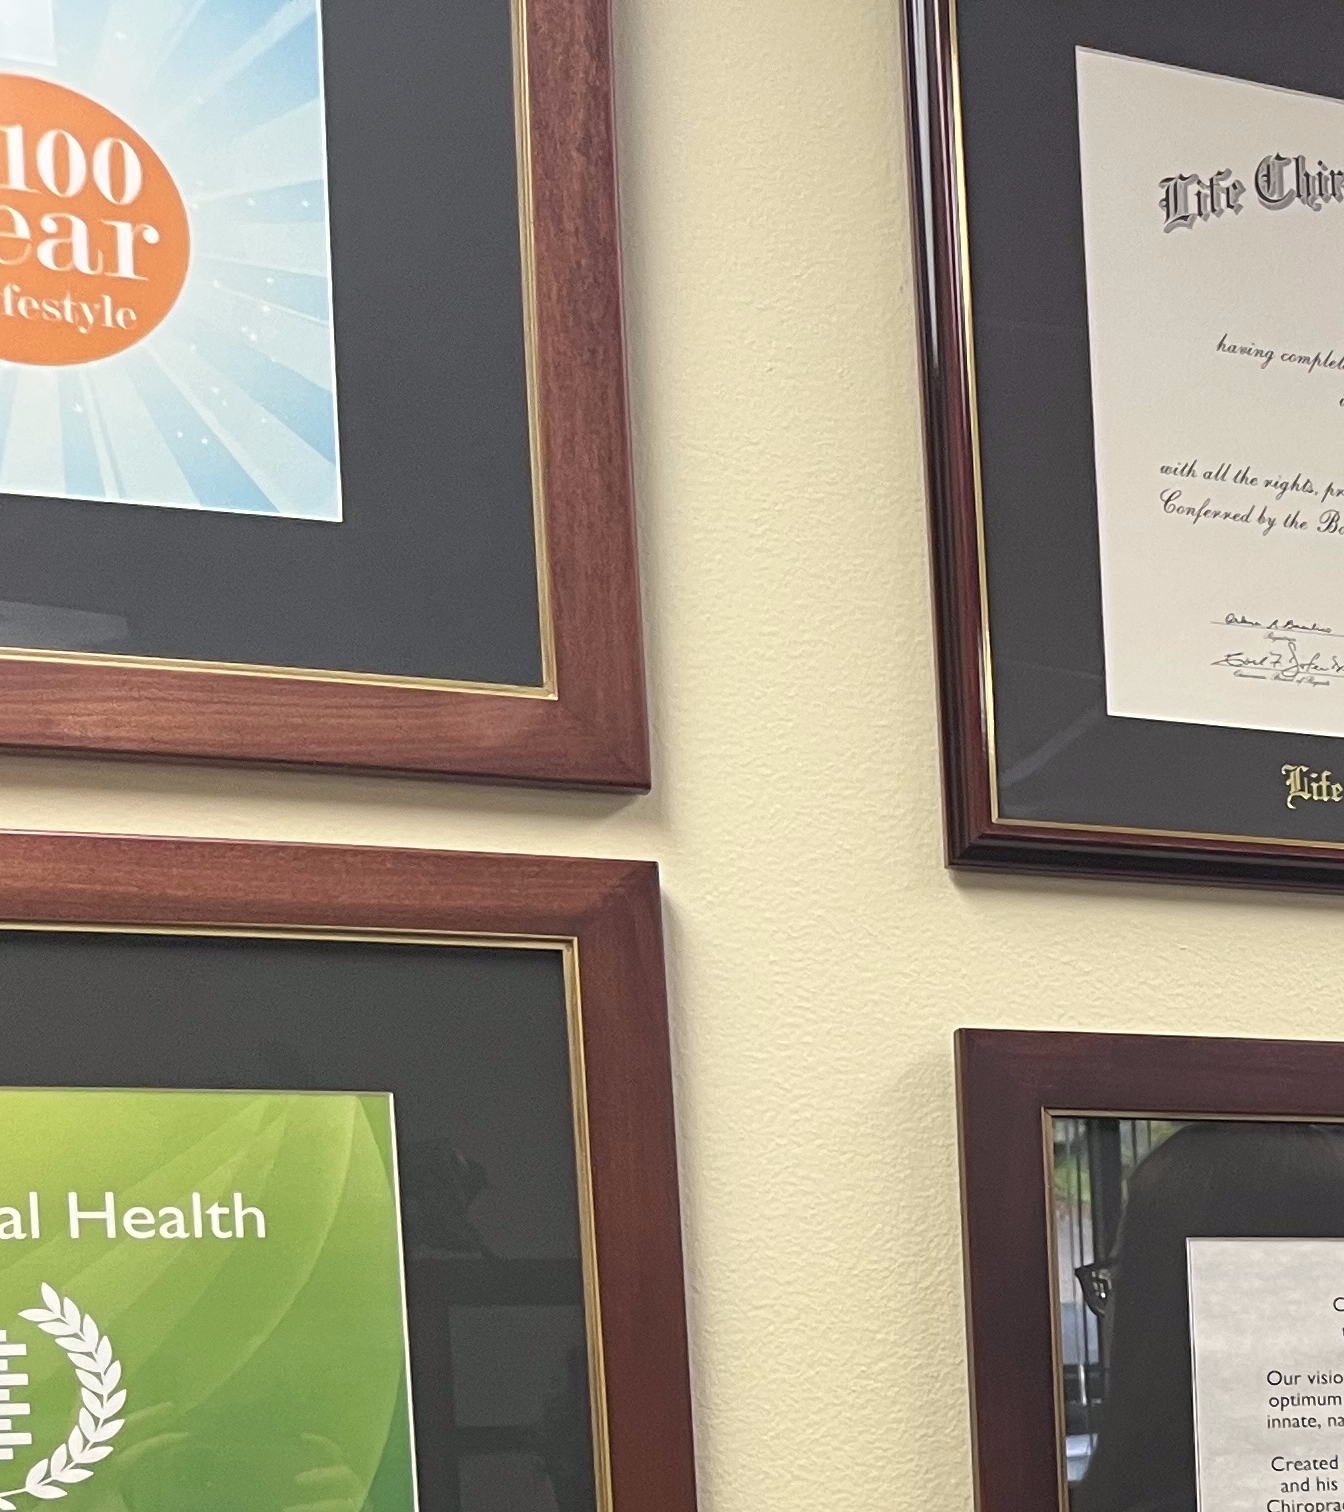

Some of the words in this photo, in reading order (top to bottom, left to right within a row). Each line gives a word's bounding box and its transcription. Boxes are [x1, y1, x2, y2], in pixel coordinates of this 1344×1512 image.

[0, 123, 143, 206] 100
[1158, 168, 1247, 233] Life
[0, 204, 160, 281] ear
[0, 283, 137, 334] festyle
[1216, 333, 1275, 370] having
[1160, 459, 1198, 478] with
[1203, 463, 1232, 482] all
[1233, 466, 1258, 487] the
[1264, 473, 1319, 501] rights,
[1160, 489, 1256, 525] Conferred
[1257, 506, 1277, 537] by
[1283, 510, 1308, 530] the
[1281, 763, 1344, 810] Life
[67, 1190, 267, 1240] Health
[1267, 1370, 1302, 1387] Our
[1267, 1415, 1322, 1430] innate,
[1271, 1455, 1339, 1472] Created
[1281, 1477, 1311, 1494] and
[1316, 1476, 1339, 1492] his
